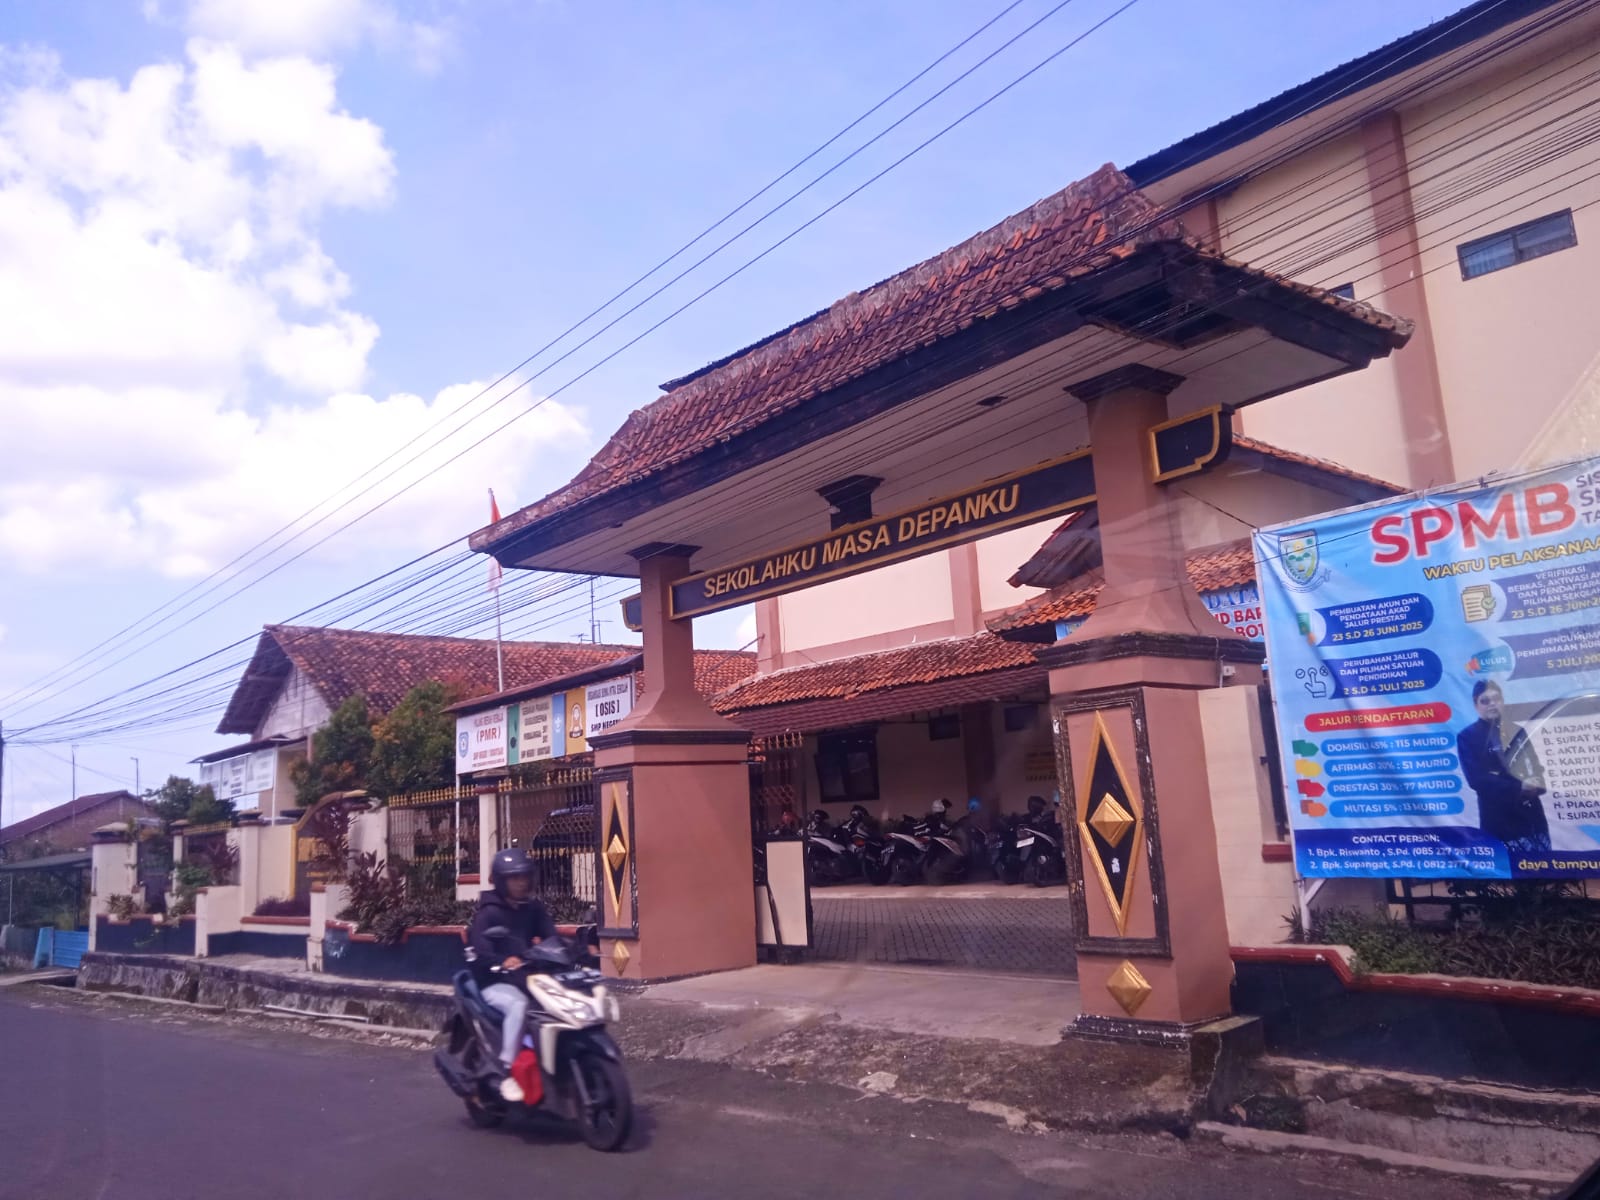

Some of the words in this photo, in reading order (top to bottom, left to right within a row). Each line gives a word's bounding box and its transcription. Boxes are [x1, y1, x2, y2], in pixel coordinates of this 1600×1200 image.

[1371, 482, 1577, 564] SPMB
[704, 550, 815, 598] SEKOLAHKU
[822, 525, 892, 565] MASA
[898, 484, 1019, 541] DEPANKU
[1423, 557, 1485, 580] WAKTU
[1535, 565, 1586, 580] VERIFIKASI
[1507, 581, 1545, 593] BERKAS,
[1547, 573, 1589, 587] AKTIVASI
[1518, 590, 1538, 599] DAN
[1523, 594, 1561, 606] PILIHAN
[1329, 603, 1376, 616] PEMBUATAN
[1378, 600, 1400, 609] AKUN
[1401, 597, 1419, 605] DAN
[1511, 609, 1525, 619] 23
[1527, 607, 1546, 617] S.D
[1565, 600, 1590, 611] JUNI
[1340, 610, 1387, 622] PENDATAAN
[1345, 619, 1370, 628] JALUR
[1370, 613, 1407, 625] PRESTASI
[1332, 633, 1344, 642] 23
[1345, 630, 1362, 640] S.D
[1362, 628, 1375, 638] 26
[1376, 625, 1399, 636] JUNI
[1400, 621, 1424, 632] 2025
[1516, 643, 1578, 658] PENERIMAAN
[1343, 655, 1392, 668] PERUBAHAN
[1393, 651, 1419, 661] JALUR
[1480, 656, 1506, 666] LULUS
[1547, 659, 1554, 669] 5
[1557, 656, 1582, 668] JULI
[1340, 668, 1358, 676] DAN
[1360, 663, 1390, 674] PILIHAN
[1391, 659, 1424, 669] SATUAN
[1359, 670, 1408, 682] PENDIDIKAN
[1343, 687, 1349, 695] 2
[1351, 686, 1368, 695] S.D
[1378, 682, 1400, 692] JULI
[1401, 679, 1425, 689] 2025
[1319, 714, 1352, 727] JALUR
[1352, 708, 1434, 725] PENDAFTARAN
[1395, 739, 1410, 748] 115
[1413, 736, 1448, 747] MURID
[1556, 734, 1590, 745] SURAT
[1558, 745, 1586, 755] AKTA
[1331, 761, 1376, 773] AFIRMASI
[1402, 760, 1413, 770] 51
[1416, 758, 1450, 769] MURID
[1560, 756, 1595, 766] KARTU
[1560, 767, 1595, 777] KARTU
[1333, 782, 1379, 793] PRESTASI
[1404, 782, 1416, 791] 77
[1418, 780, 1455, 791] MURID
[1344, 803, 1381, 814] MUTASI
[1383, 803, 1397, 812] 5%
[1412, 802, 1448, 812] MURID
[1352, 834, 1396, 844] CONTACT
[1399, 834, 1440, 843] PERSON:
[1307, 848, 1315, 856] 1.
[1316, 848, 1338, 859] Bpk.
[1339, 848, 1380, 857] Riswanto
[1387, 847, 1410, 856] S.Pd.
[1412, 847, 1434, 857] (085
[1472, 846, 1495, 857] 135)
[1309, 861, 1318, 869] 2.
[1322, 861, 1342, 870] Bpk.
[1392, 860, 1415, 869] S.Pd.
[1423, 860, 1446, 869] 0812
[1518, 859, 1548, 871] daya
